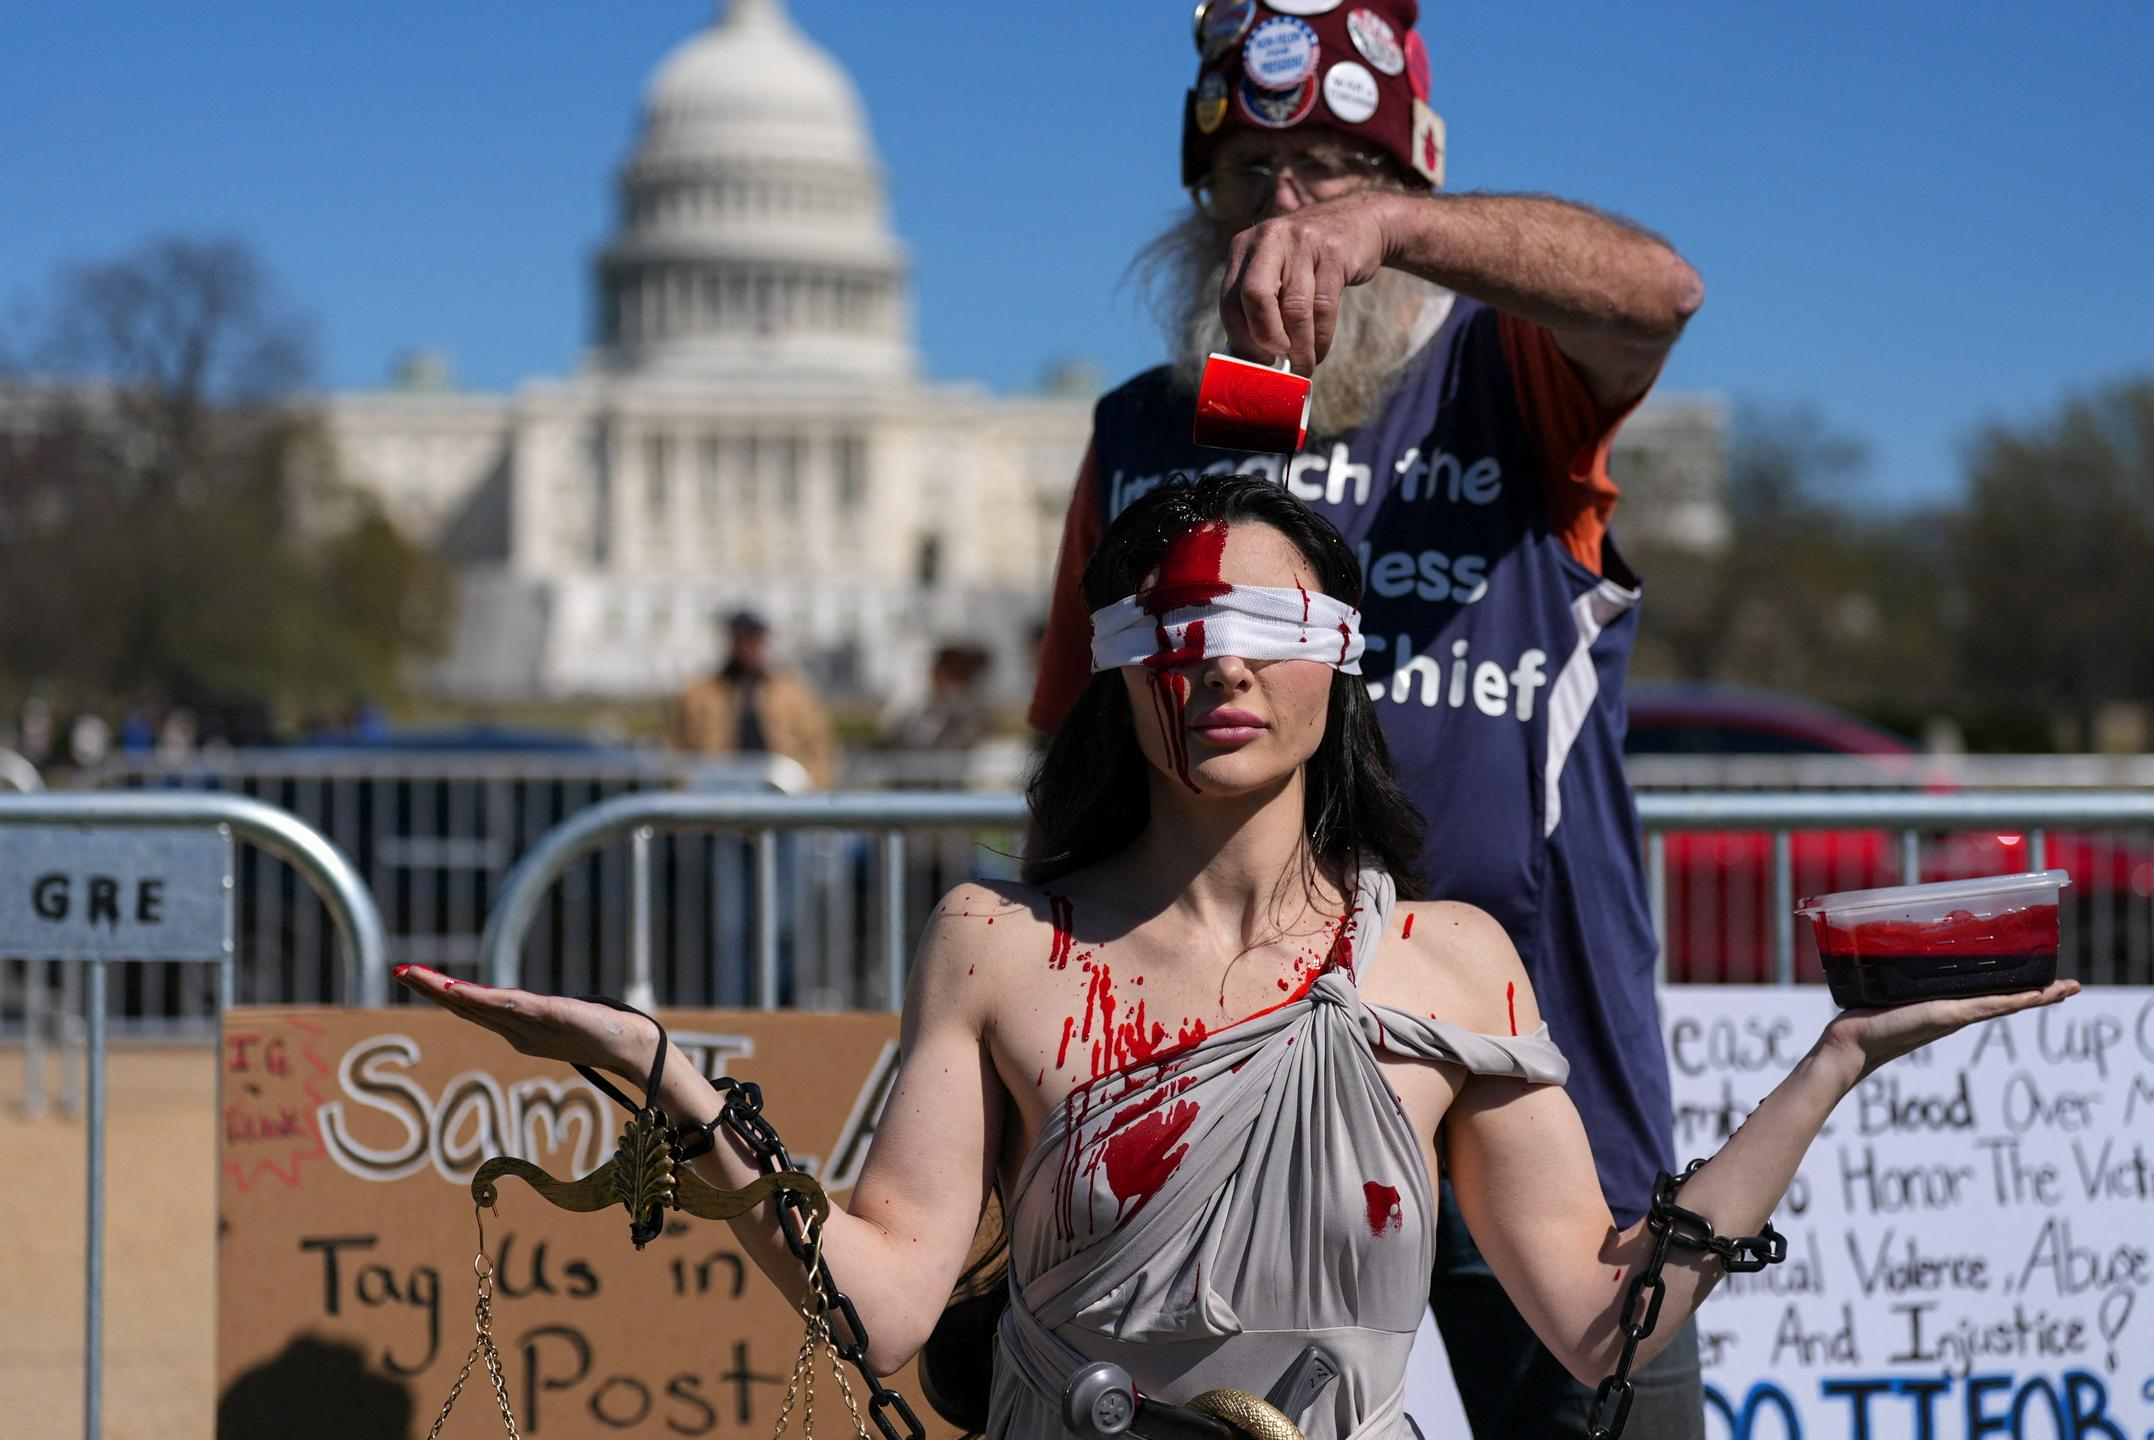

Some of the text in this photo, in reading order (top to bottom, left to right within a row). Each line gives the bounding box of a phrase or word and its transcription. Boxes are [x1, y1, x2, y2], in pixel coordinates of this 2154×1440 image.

[1395, 447, 1502, 504] the
[1357, 541, 1488, 604] less
[31, 873, 166, 937] GRE
[1661, 1015, 1800, 1077] ease
[1969, 1014, 2018, 1067] A
[2036, 1003, 2124, 1080] Cup
[1857, 1070, 1976, 1135] Blood
[2002, 1069, 2103, 1133] Over
[1838, 1143, 1974, 1214] Honor
[1973, 1136, 2064, 1207] The
[2071, 1137, 2154, 1200] Vict
[297, 1221, 748, 1375] Tag Us in
[1769, 1303, 1860, 1367] And
[514, 1322, 788, 1435] Post
